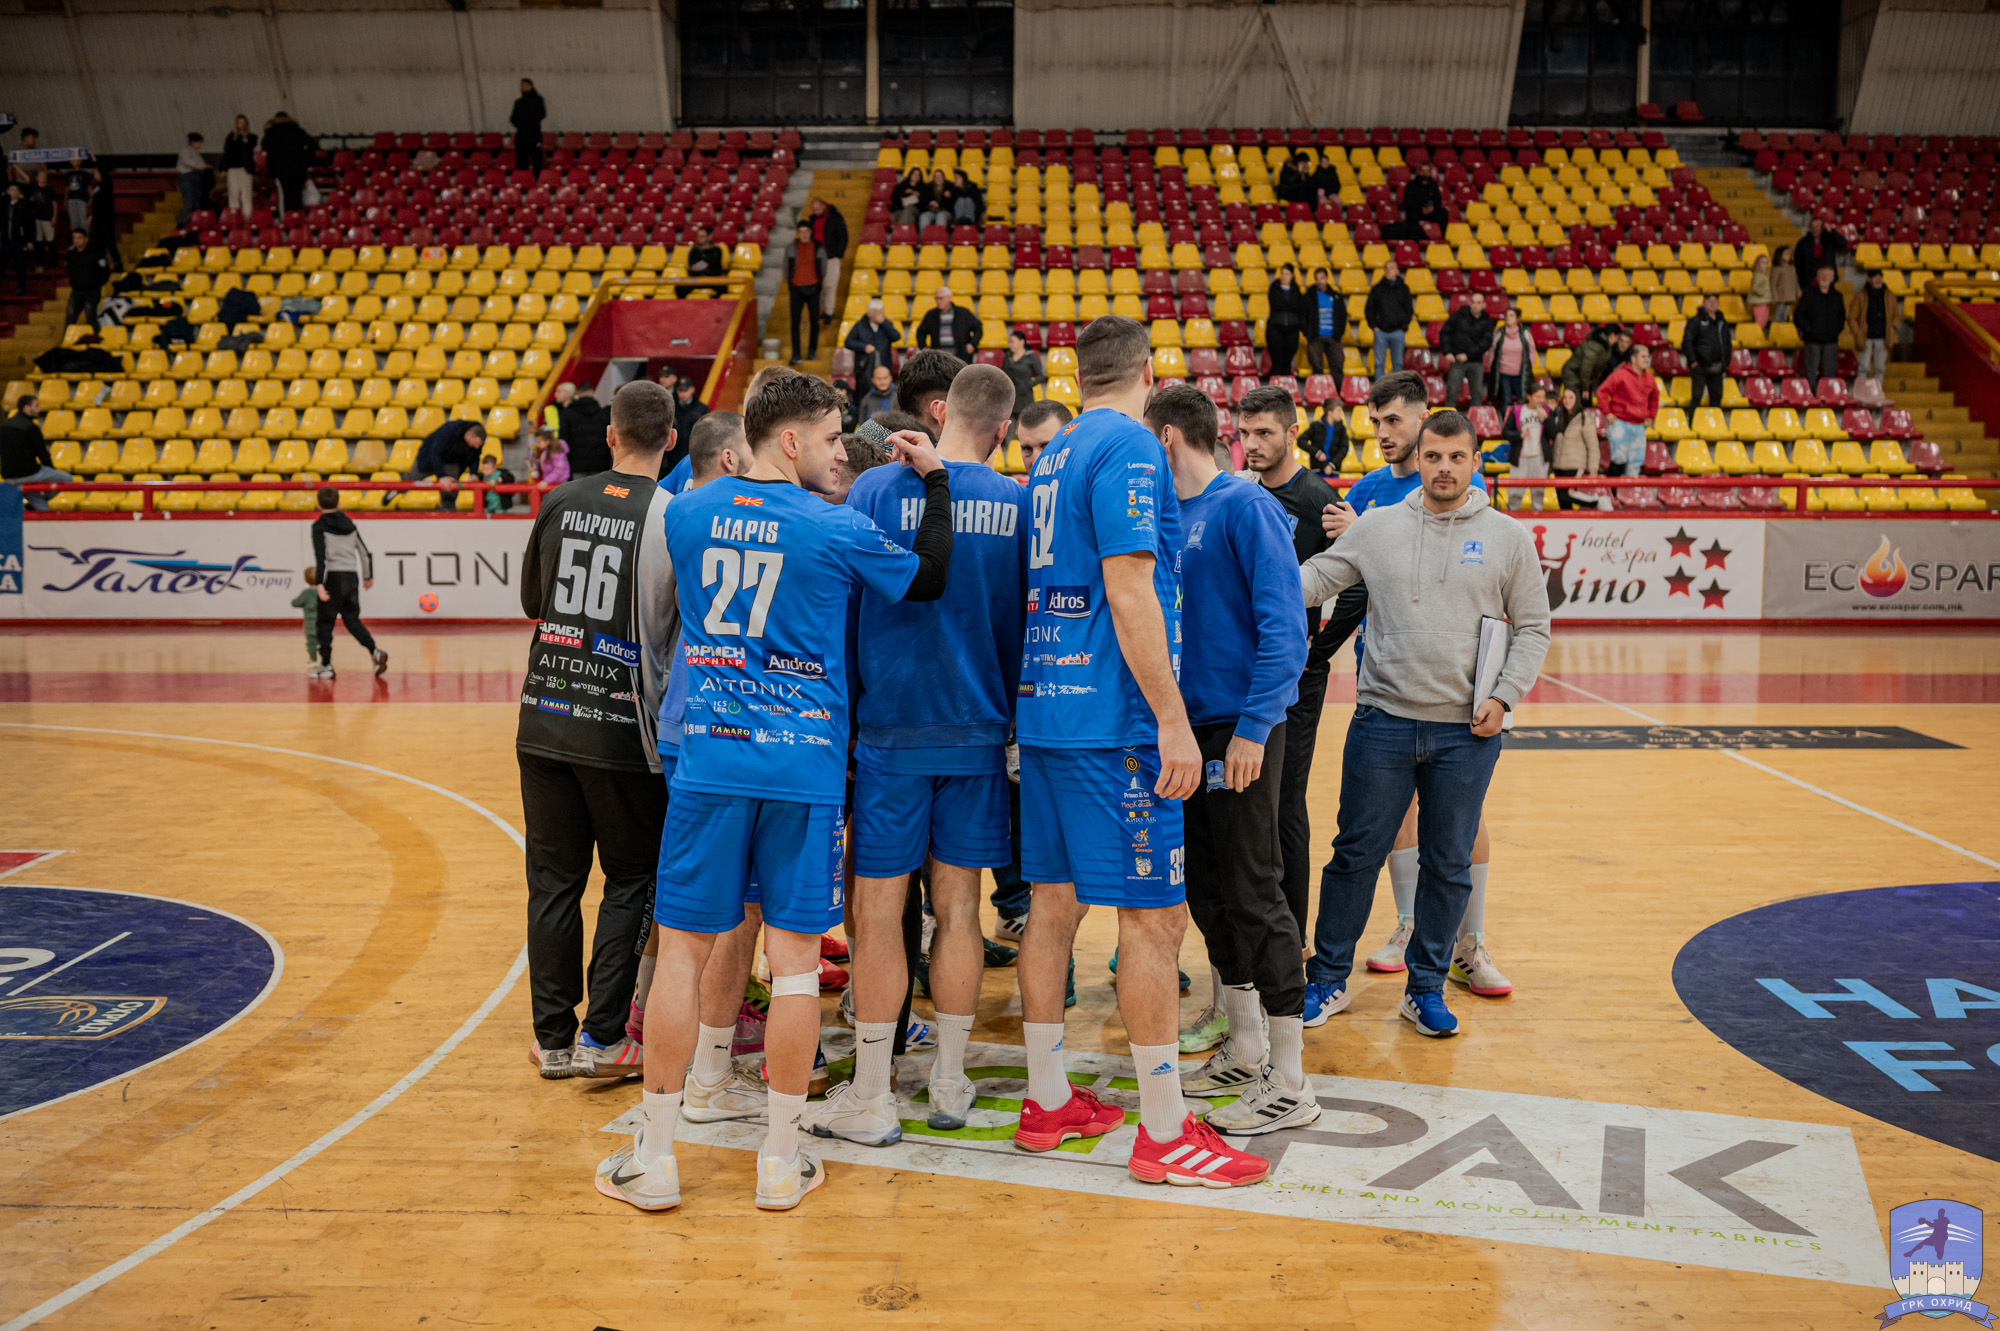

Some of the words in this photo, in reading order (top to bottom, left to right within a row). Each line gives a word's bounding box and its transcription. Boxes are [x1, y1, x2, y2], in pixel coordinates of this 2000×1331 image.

[560, 510, 635, 541] PILIPOVIC
[710, 515, 779, 544] LIAPIS
[1581, 526, 1632, 548] hotel
[383, 551, 511, 586] TON
[1600, 551, 1615, 564] &
[1621, 548, 1657, 573] spa
[554, 537, 622, 621] 56
[702, 547, 784, 638] 27
[539, 621, 584, 640] АРМЕН
[596, 638, 637, 661] Andros
[539, 653, 619, 681] AITONIX
[768, 654, 823, 674] Andros
[546, 681, 556, 689] LED
[700, 677, 803, 699] AITONIX
[540, 699, 570, 711] TAMARO
[713, 706, 727, 714] LED
[711, 725, 750, 736] TAMARO
[1150, 1067, 1176, 1076] adidas
[1253, 1179, 1346, 1196] SCHEL
[1362, 1191, 1420, 1203] AND
[1434, 1199, 1677, 1233] MONOFILAMENT
[1692, 1228, 1822, 1251] FABRICS
